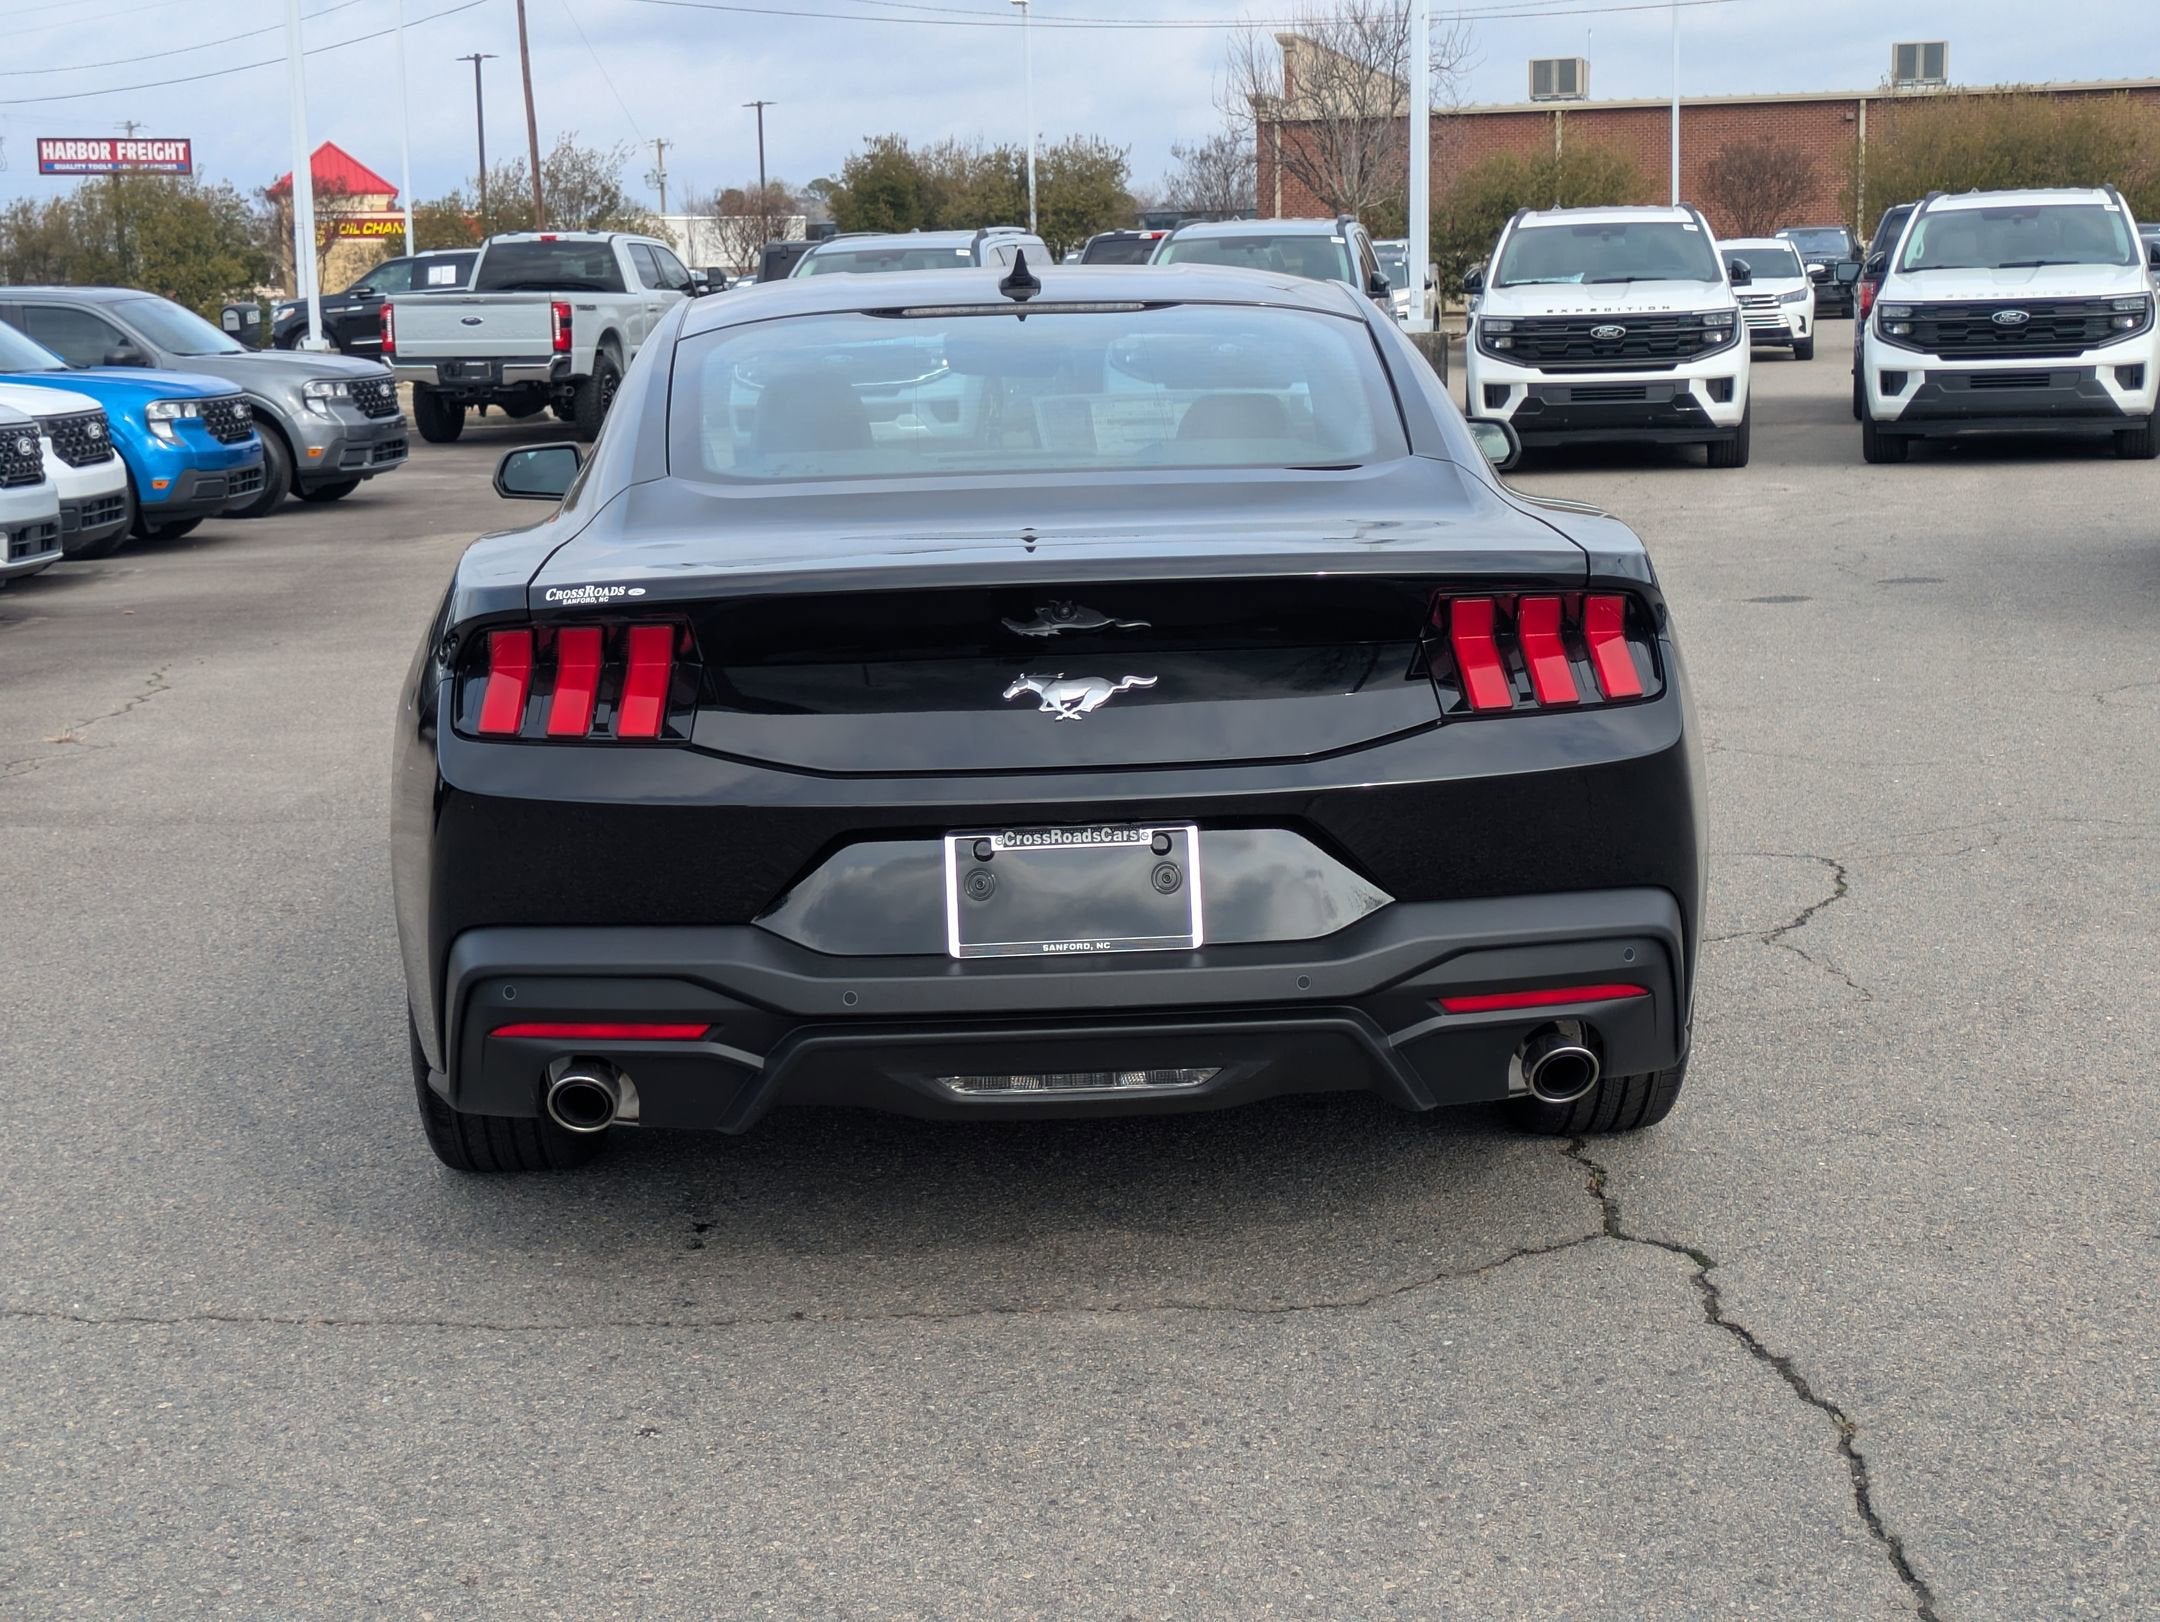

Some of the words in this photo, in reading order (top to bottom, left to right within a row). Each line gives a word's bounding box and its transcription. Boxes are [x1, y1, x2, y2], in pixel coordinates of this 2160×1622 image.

[42, 142, 111, 160] HARBOR
[116, 142, 186, 161] FREIGHT
[339, 223, 360, 235] OIL
[363, 222, 407, 234] CHAN
[1546, 305, 1670, 314] EXPEDITION
[1003, 827, 1139, 847] CrossRoadsCars
[1042, 942, 1093, 952] SANFORD,
[1096, 942, 1111, 950] NC
